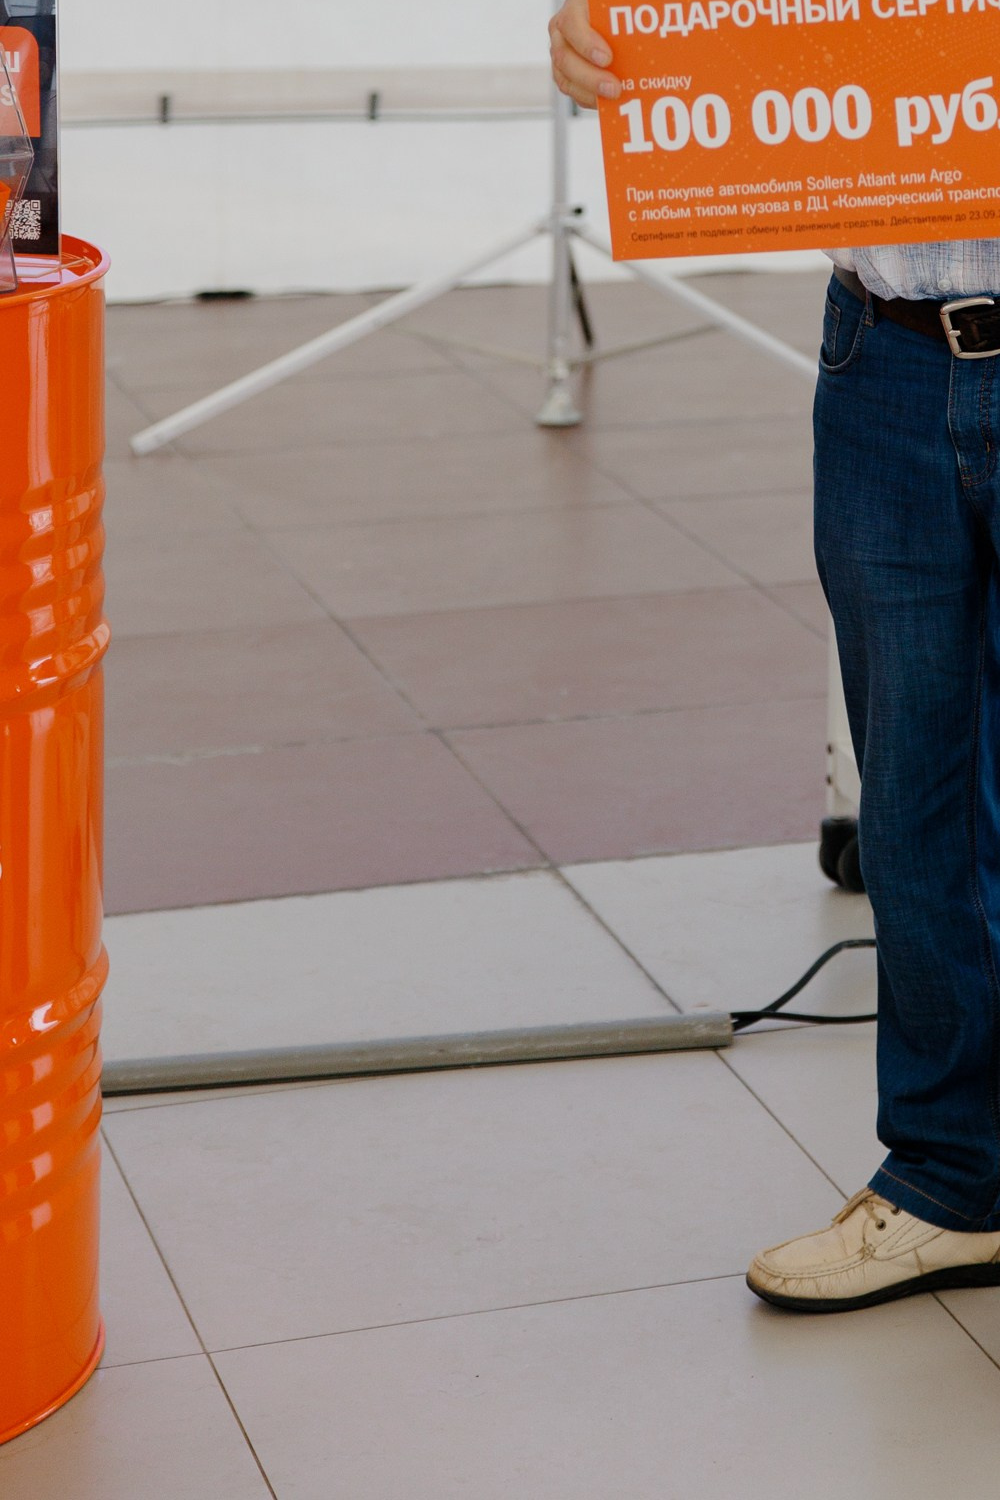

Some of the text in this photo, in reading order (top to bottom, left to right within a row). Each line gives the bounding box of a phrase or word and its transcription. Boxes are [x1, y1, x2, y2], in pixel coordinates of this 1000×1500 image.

[639, 75, 692, 91] скидку
[619, 93, 732, 153] 100
[751, 84, 873, 146] 000
[626, 168, 963, 204] При покупке автомобиля Sollers Atlant или Argo
[628, 209, 637, 221] с
[641, 205, 691, 221] любым
[694, 203, 737, 218] типом
[741, 199, 790, 217] кузова
[794, 199, 803, 211] в
[806, 195, 829, 212] ДЦ
[832, 187, 943, 208] «Коммерческий
[631, 231, 684, 242] Сертификат
[687, 230, 698, 238] не
[700, 227, 743, 238] подлежит
[747, 224, 779, 235] обмену
[782, 225, 792, 233] на
[795, 222, 840, 233] денежные
[844, 219, 887, 230] средства.
[890, 214, 953, 226] Действителен
[955, 213, 967, 222] до
